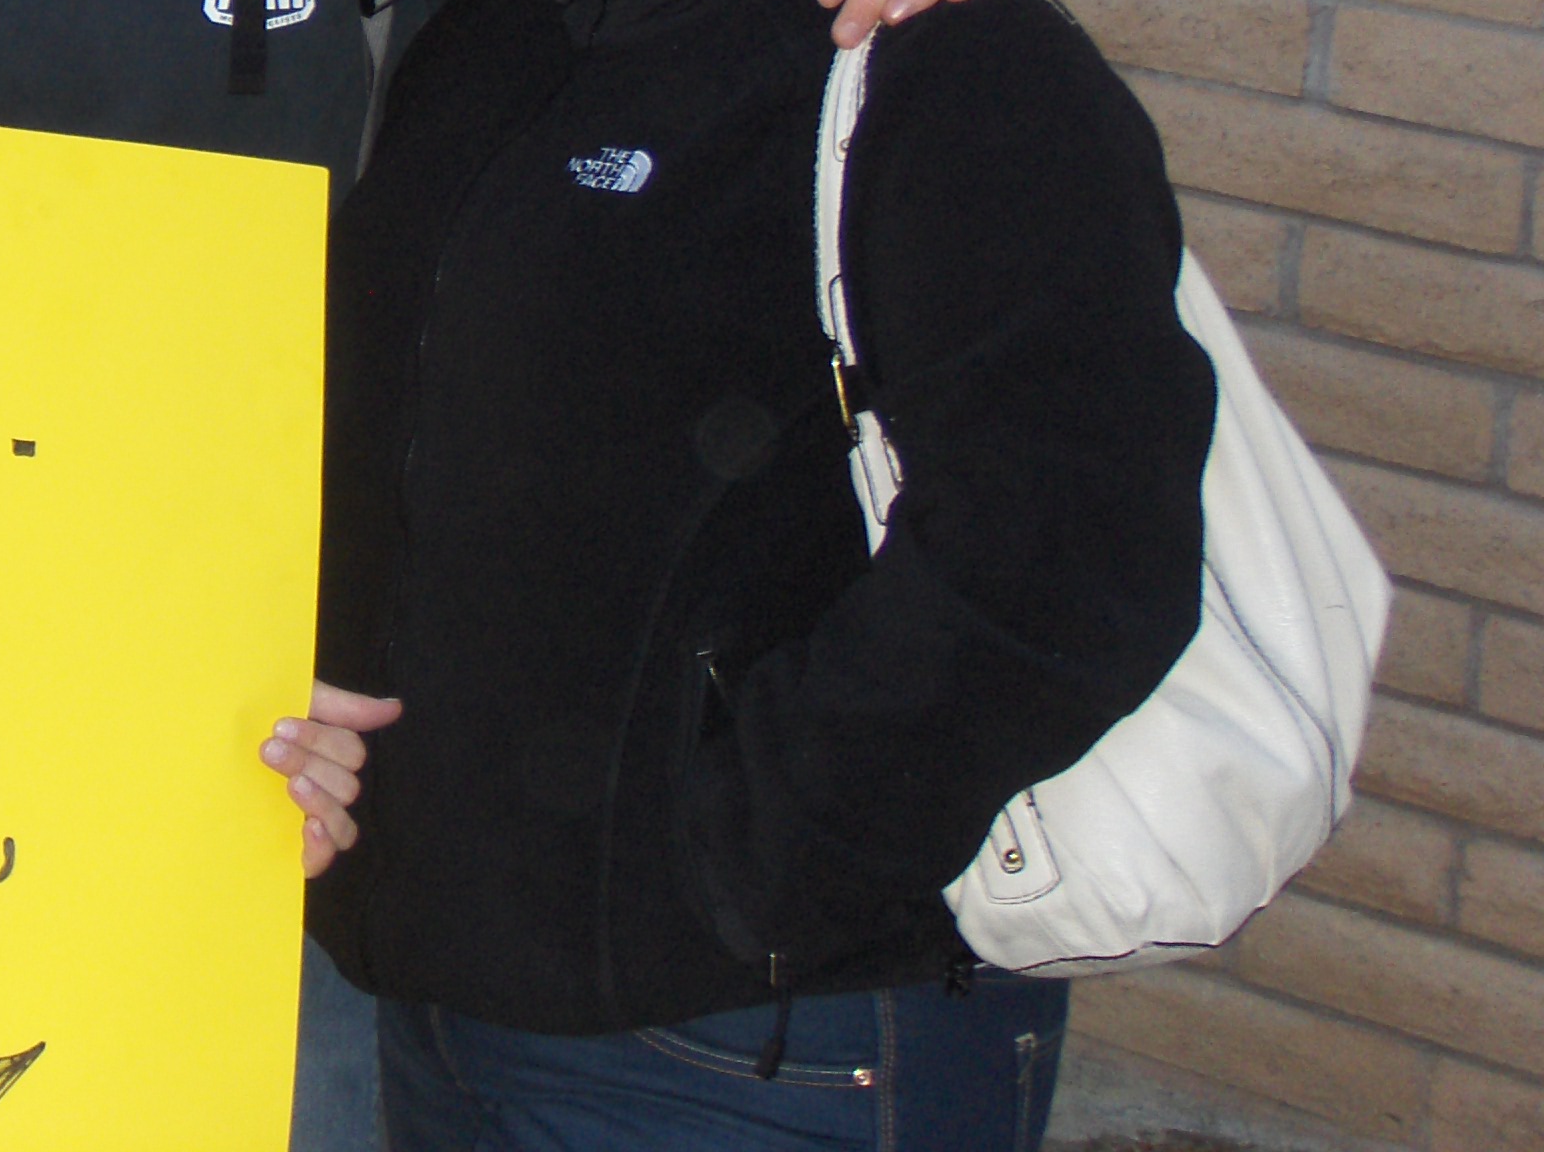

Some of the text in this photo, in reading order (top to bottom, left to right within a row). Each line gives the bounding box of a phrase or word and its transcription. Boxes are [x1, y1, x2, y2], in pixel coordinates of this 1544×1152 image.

[600, 147, 633, 164] THE
[567, 157, 622, 176] NORTH
[575, 173, 617, 189] FACE
